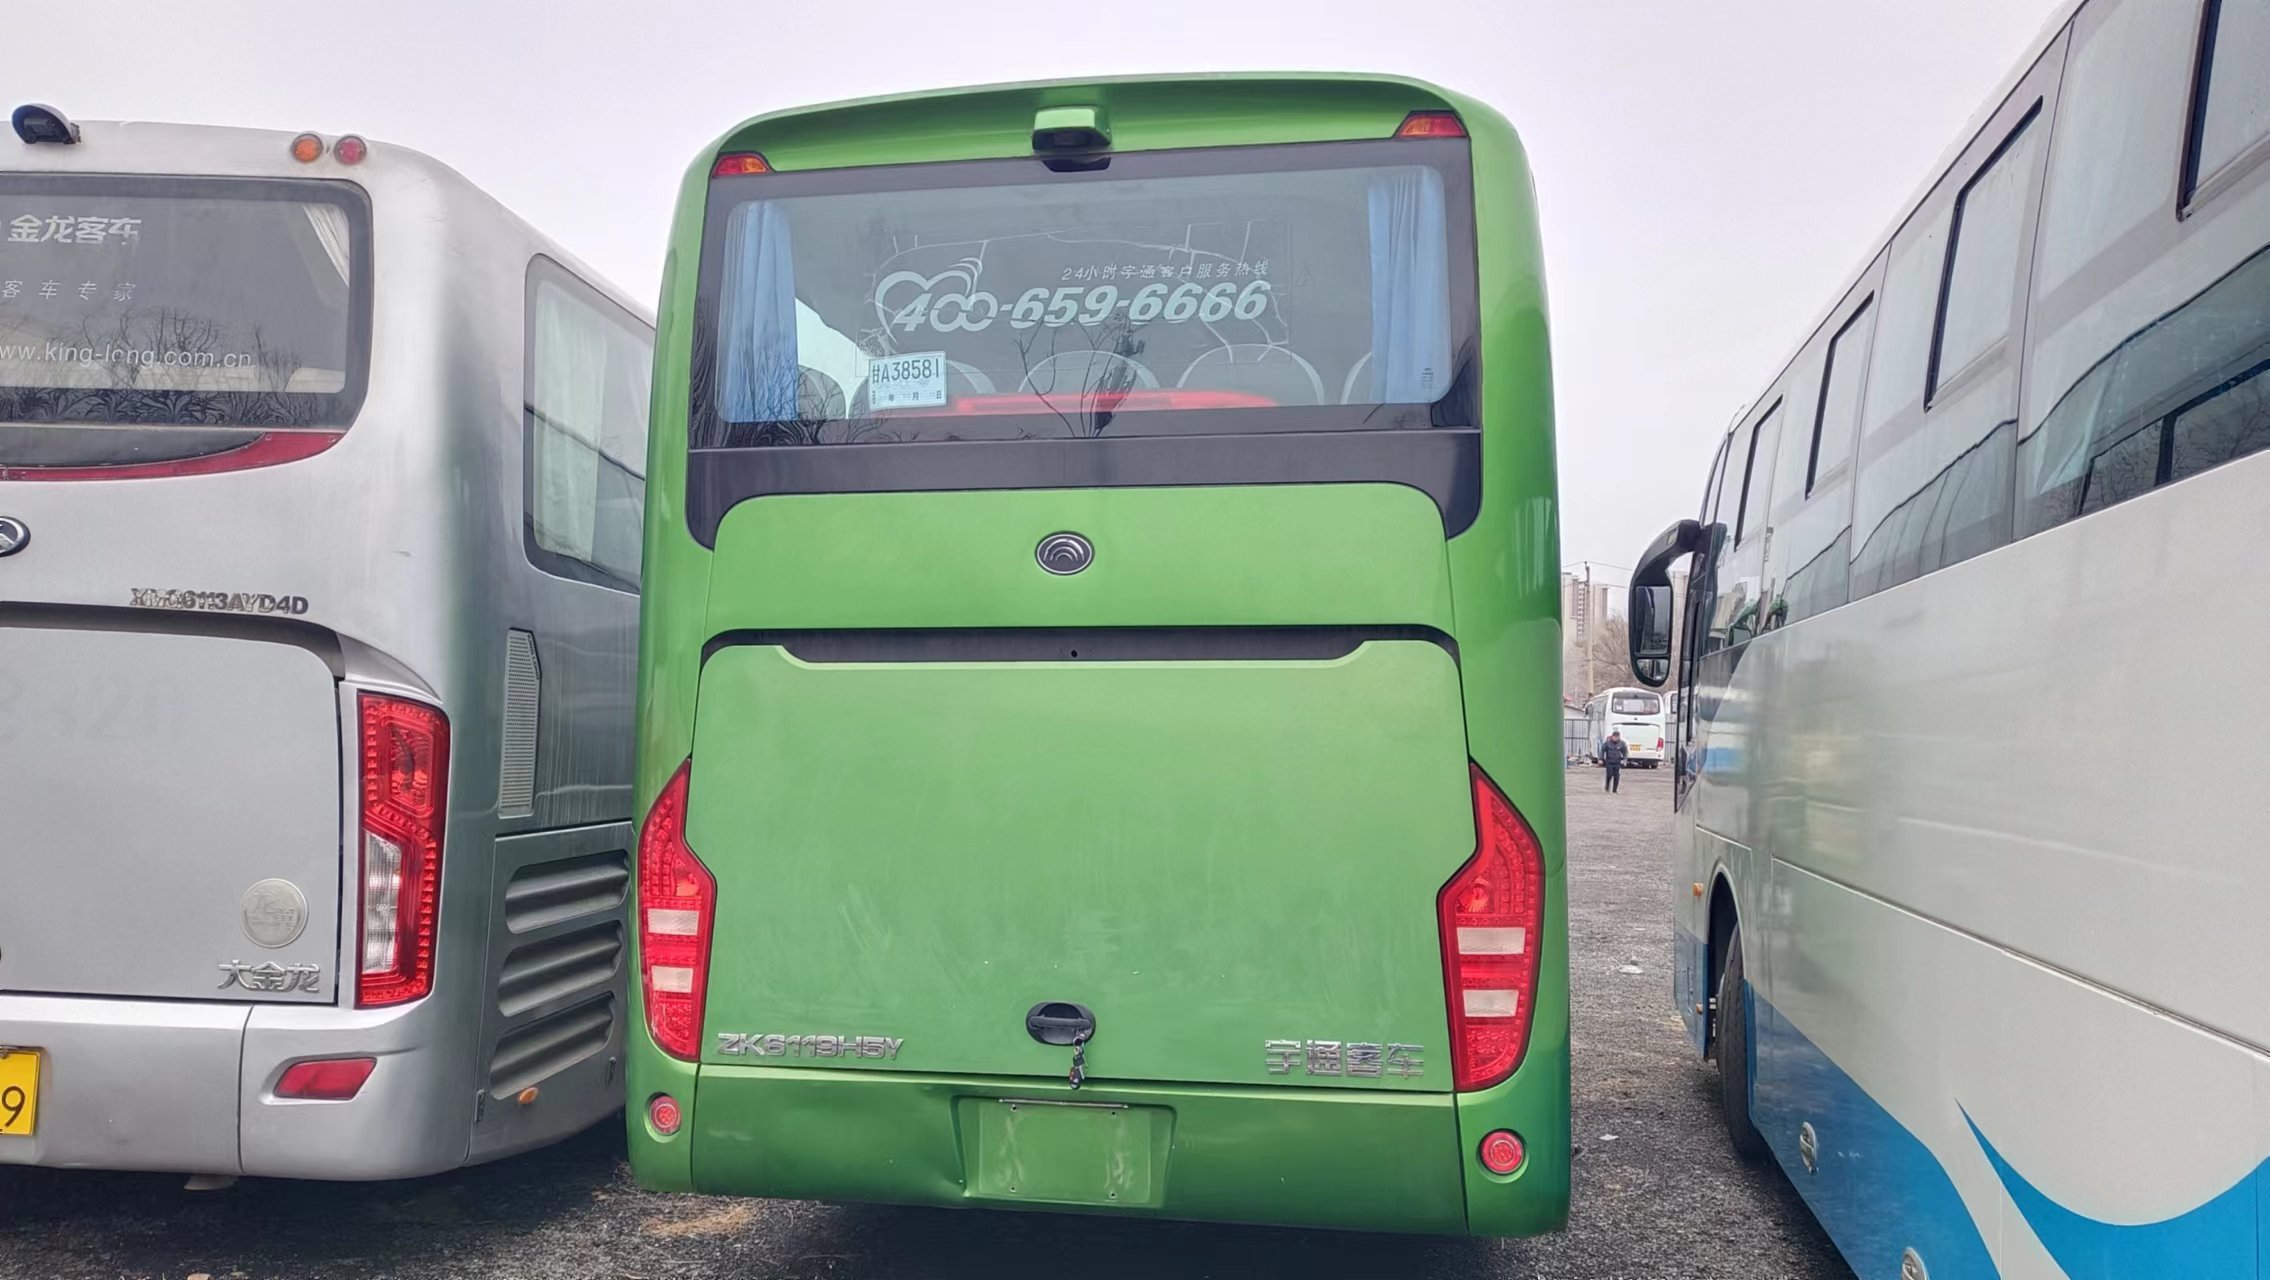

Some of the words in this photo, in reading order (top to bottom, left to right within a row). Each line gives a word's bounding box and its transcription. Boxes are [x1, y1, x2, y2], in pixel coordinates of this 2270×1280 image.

[7, 214, 142, 245] 金龙客车
[2, 279, 136, 301] 客车专家
[889, 280, 1271, 333] 400-659-6666
[872, 358, 939, 384] 甘A38581
[217, 959, 321, 994] 大金龙
[1264, 1039, 1425, 1079] 宇通客车
[1, 1085, 26, 1127] 9
